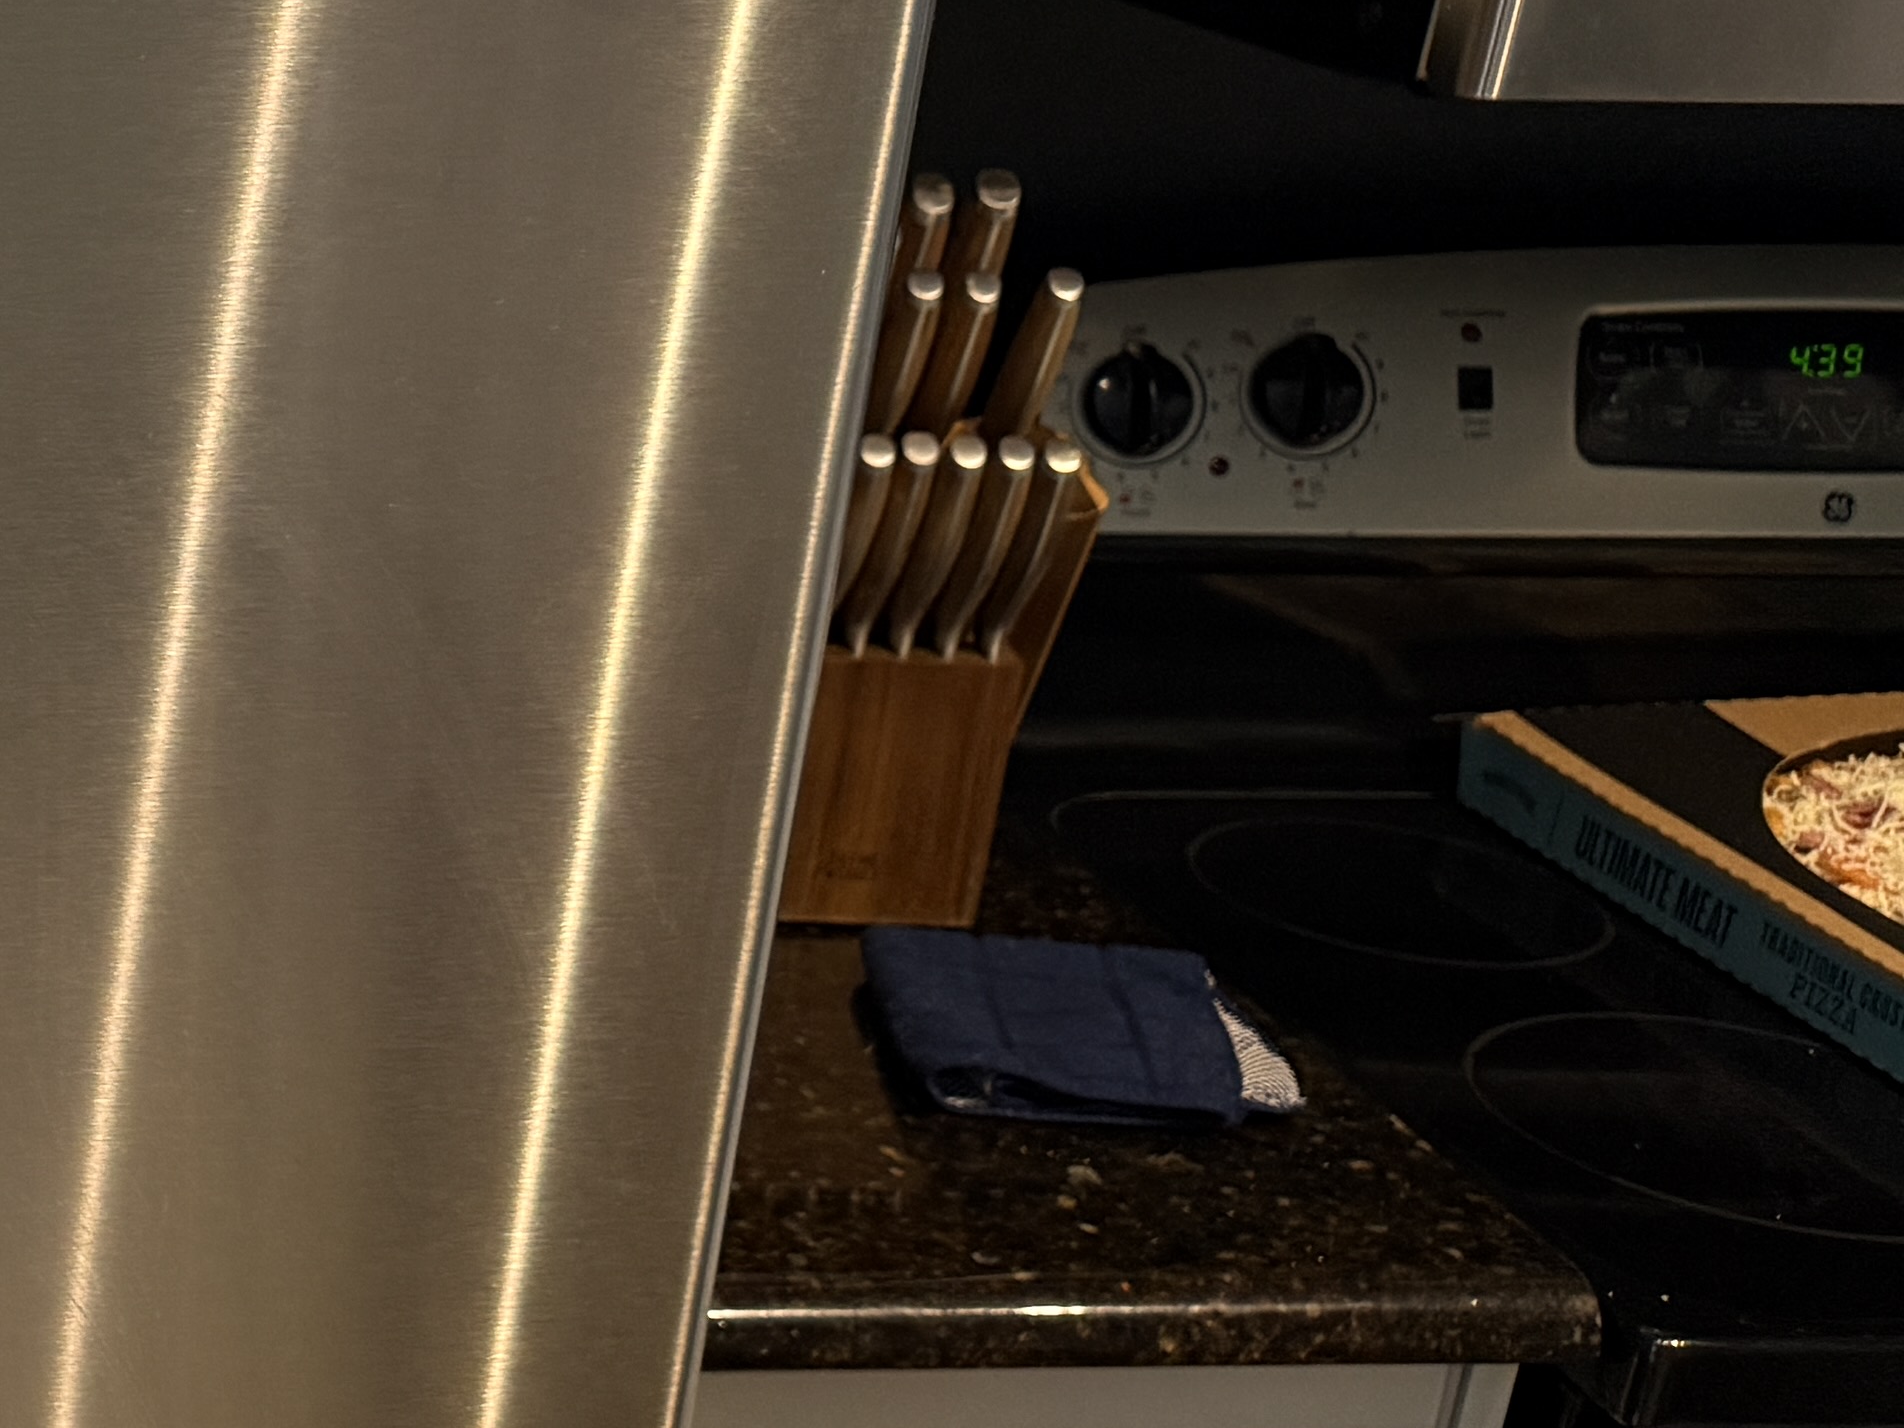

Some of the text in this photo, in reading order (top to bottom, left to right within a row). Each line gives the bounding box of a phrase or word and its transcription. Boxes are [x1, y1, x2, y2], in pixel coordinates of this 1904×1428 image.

[1574, 814, 1738, 949] ULTIMATE MEAT
[1789, 972, 1857, 1035] PIZZA
[1859, 982, 1904, 1032] CRUS
